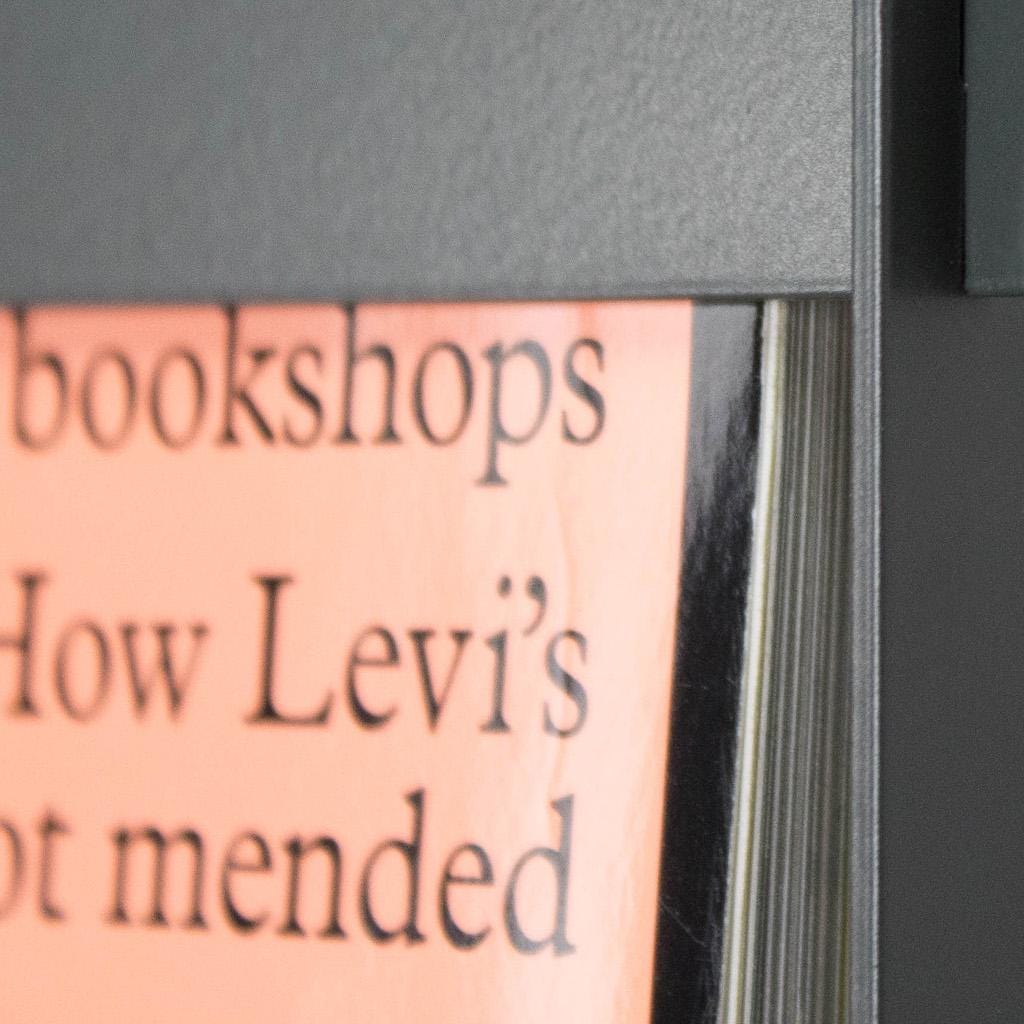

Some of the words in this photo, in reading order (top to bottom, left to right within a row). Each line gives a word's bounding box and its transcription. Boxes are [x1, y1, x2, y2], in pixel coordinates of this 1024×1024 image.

[5, 302, 608, 488] bookshops
[244, 574, 591, 740] Levi's
[104, 787, 578, 959] mended
